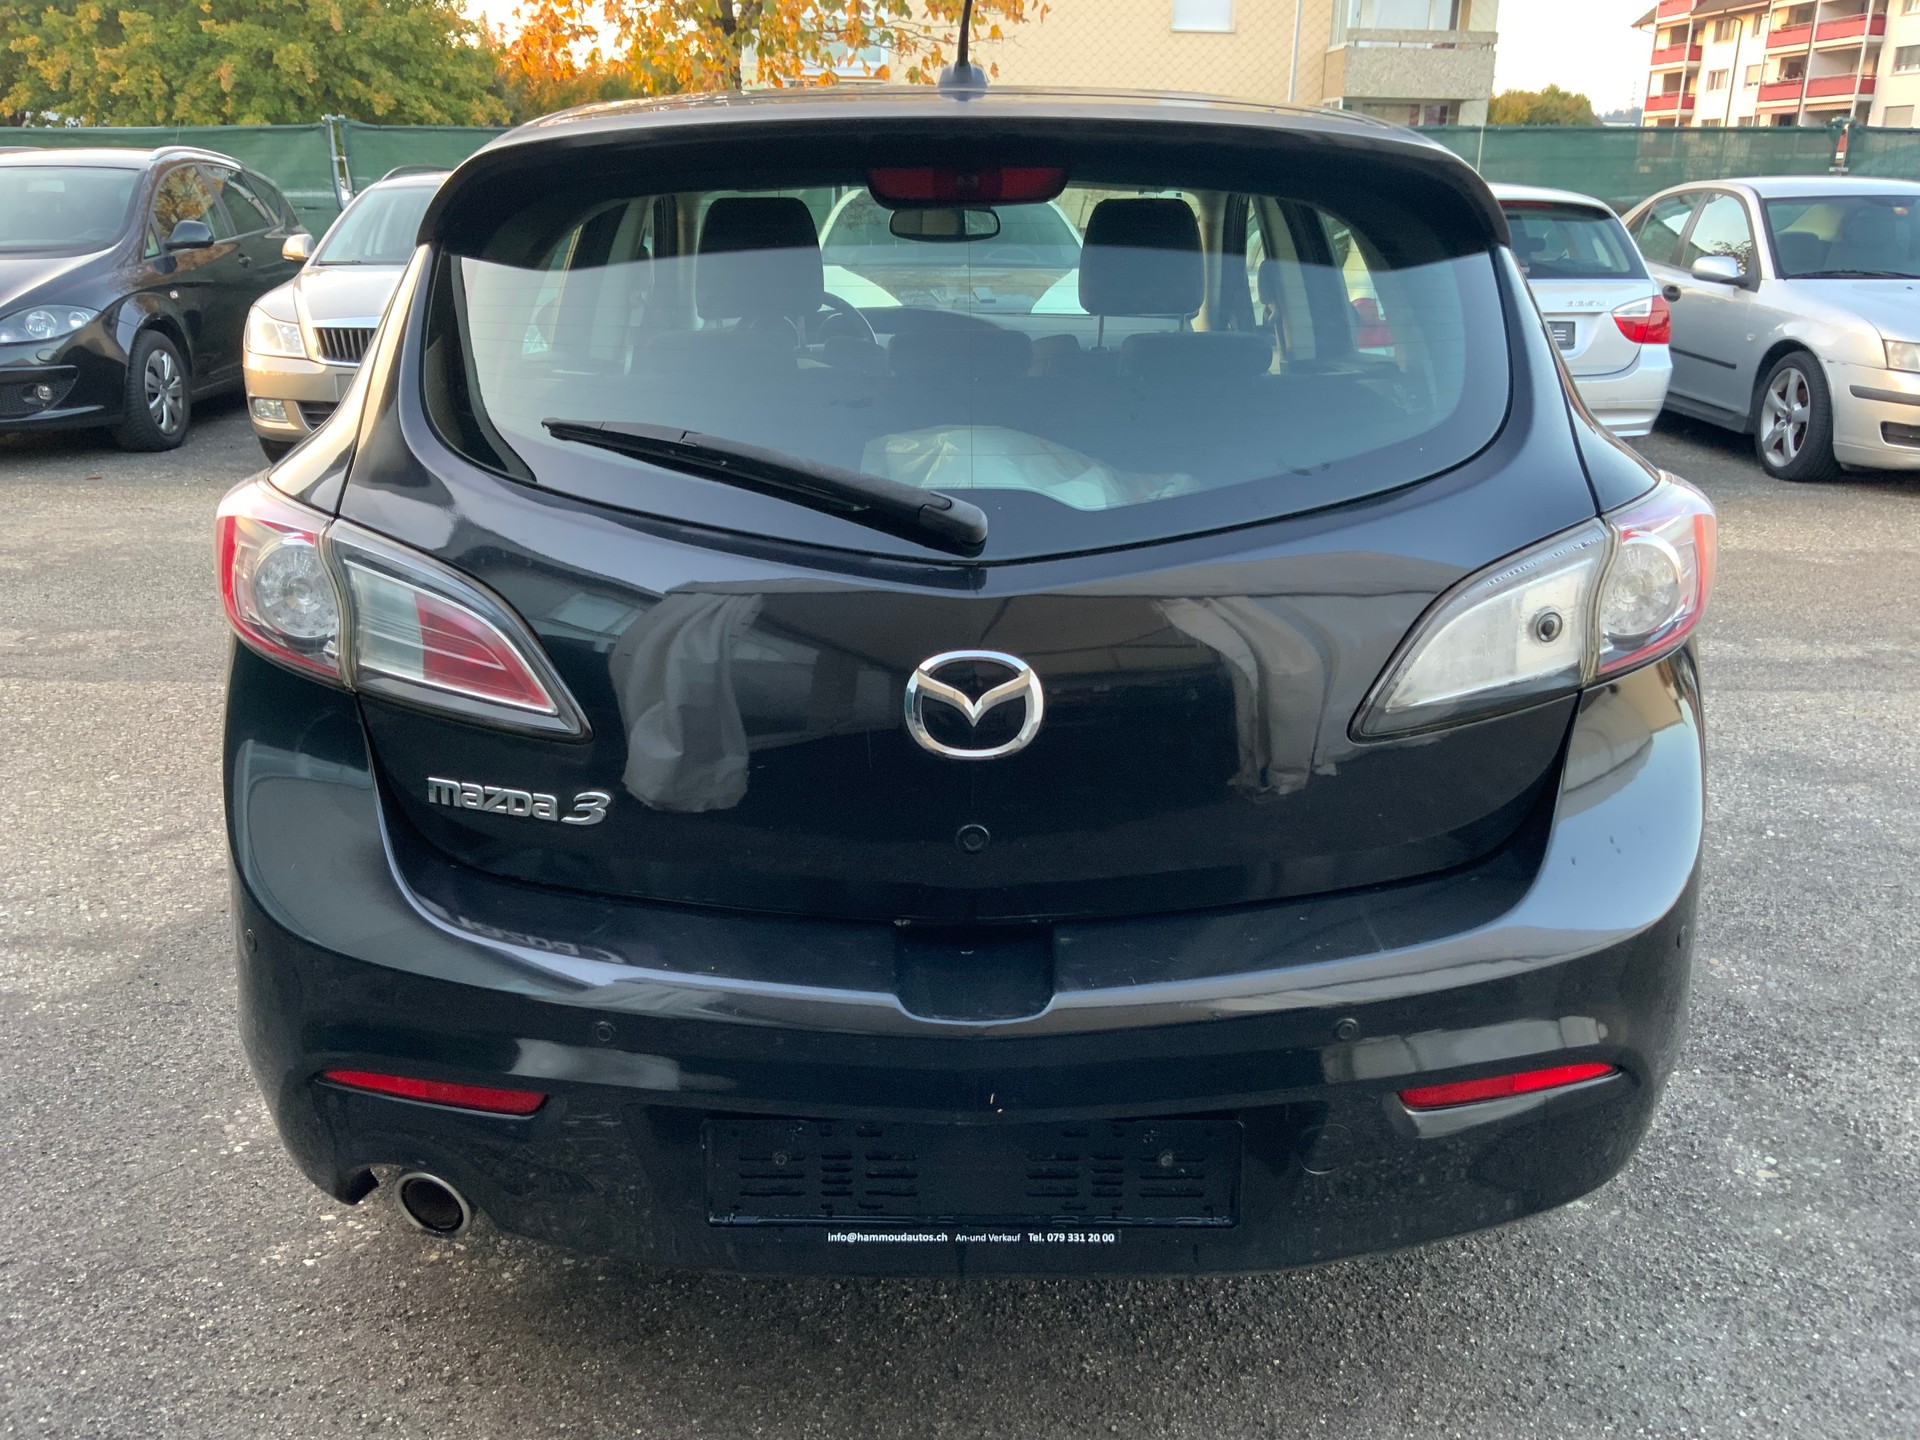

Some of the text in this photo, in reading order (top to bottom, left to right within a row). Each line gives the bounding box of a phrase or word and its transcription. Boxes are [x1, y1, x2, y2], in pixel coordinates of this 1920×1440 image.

[560, 791, 612, 826] 3
[955, 1233, 987, 1242] An-und
[988, 1233, 1021, 1242] Verkauf
[1028, 1232, 1045, 1242] Tel.
[1046, 1232, 1066, 1243] 079
[1067, 1232, 1086, 1243] 331
[1087, 1233, 1101, 1243] 20
[1101, 1233, 1115, 1243] 00
